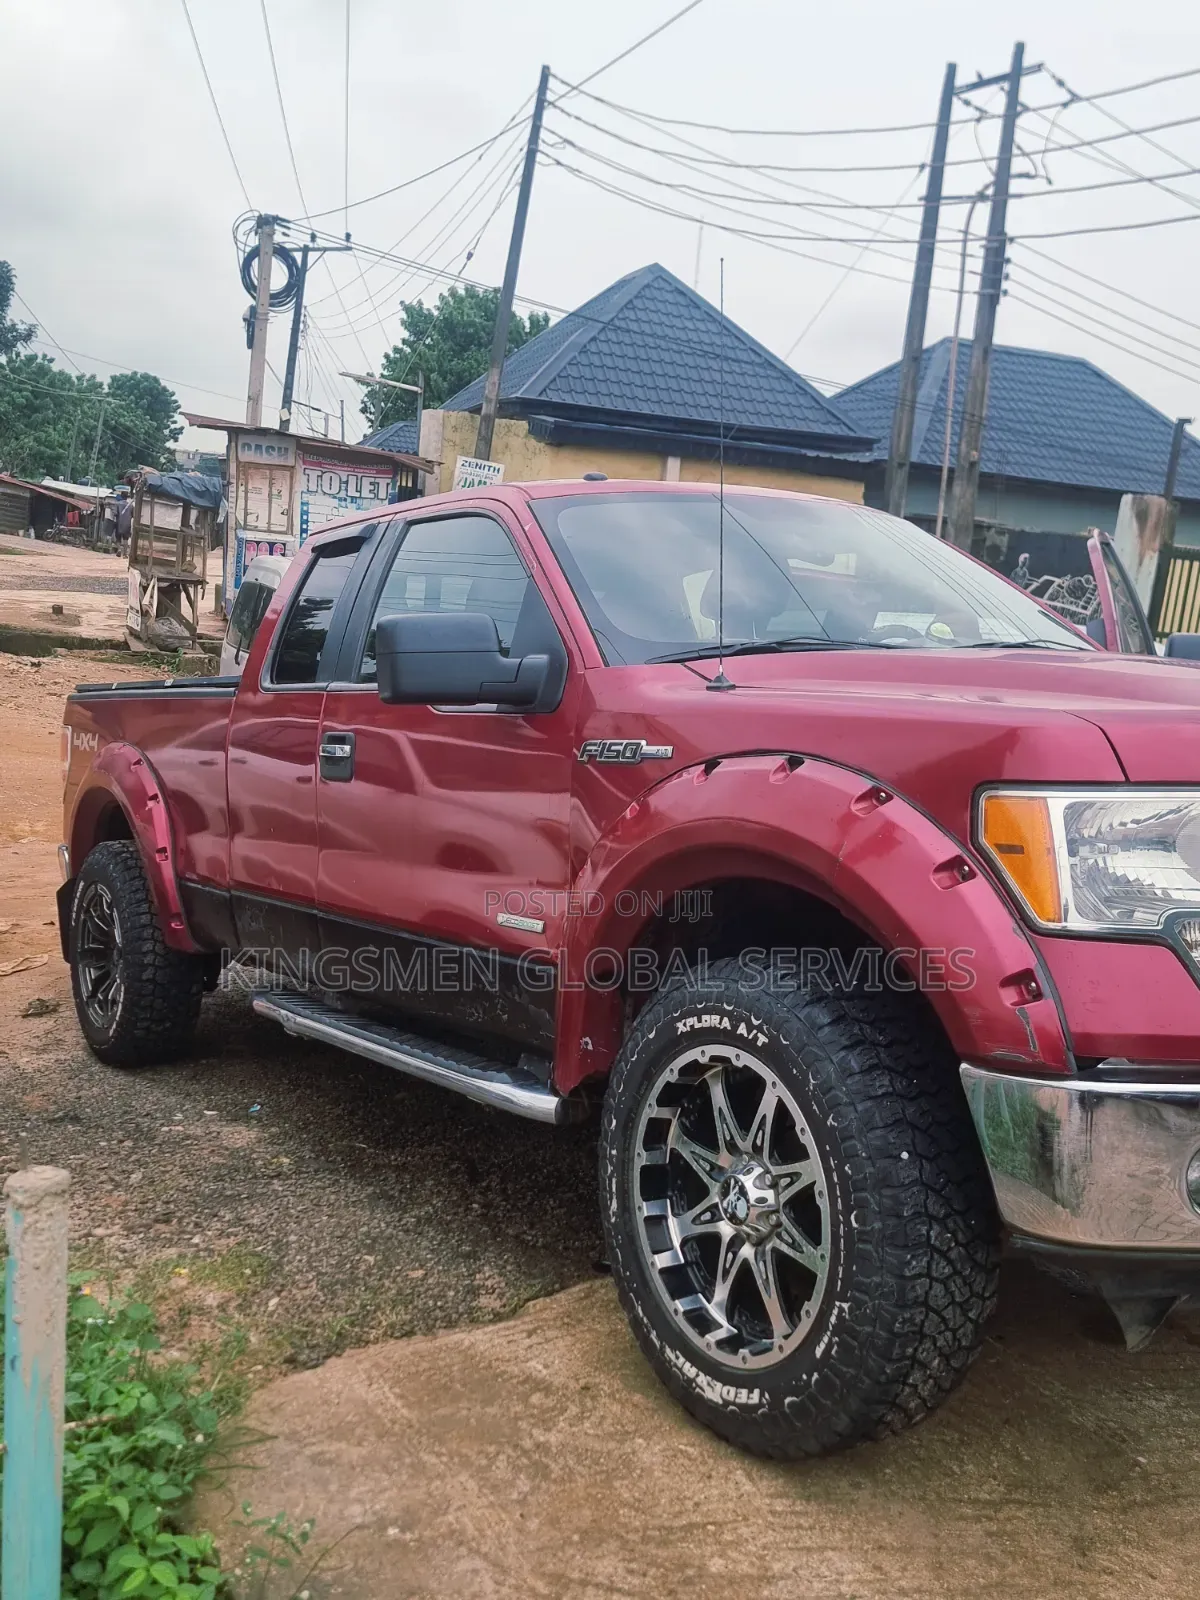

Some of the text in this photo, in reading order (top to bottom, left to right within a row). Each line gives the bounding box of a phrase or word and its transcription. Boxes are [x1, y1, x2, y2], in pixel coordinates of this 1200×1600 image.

[461, 459, 501, 475] ZENITH
[675, 1014, 769, 1047] XPLORA A/T
